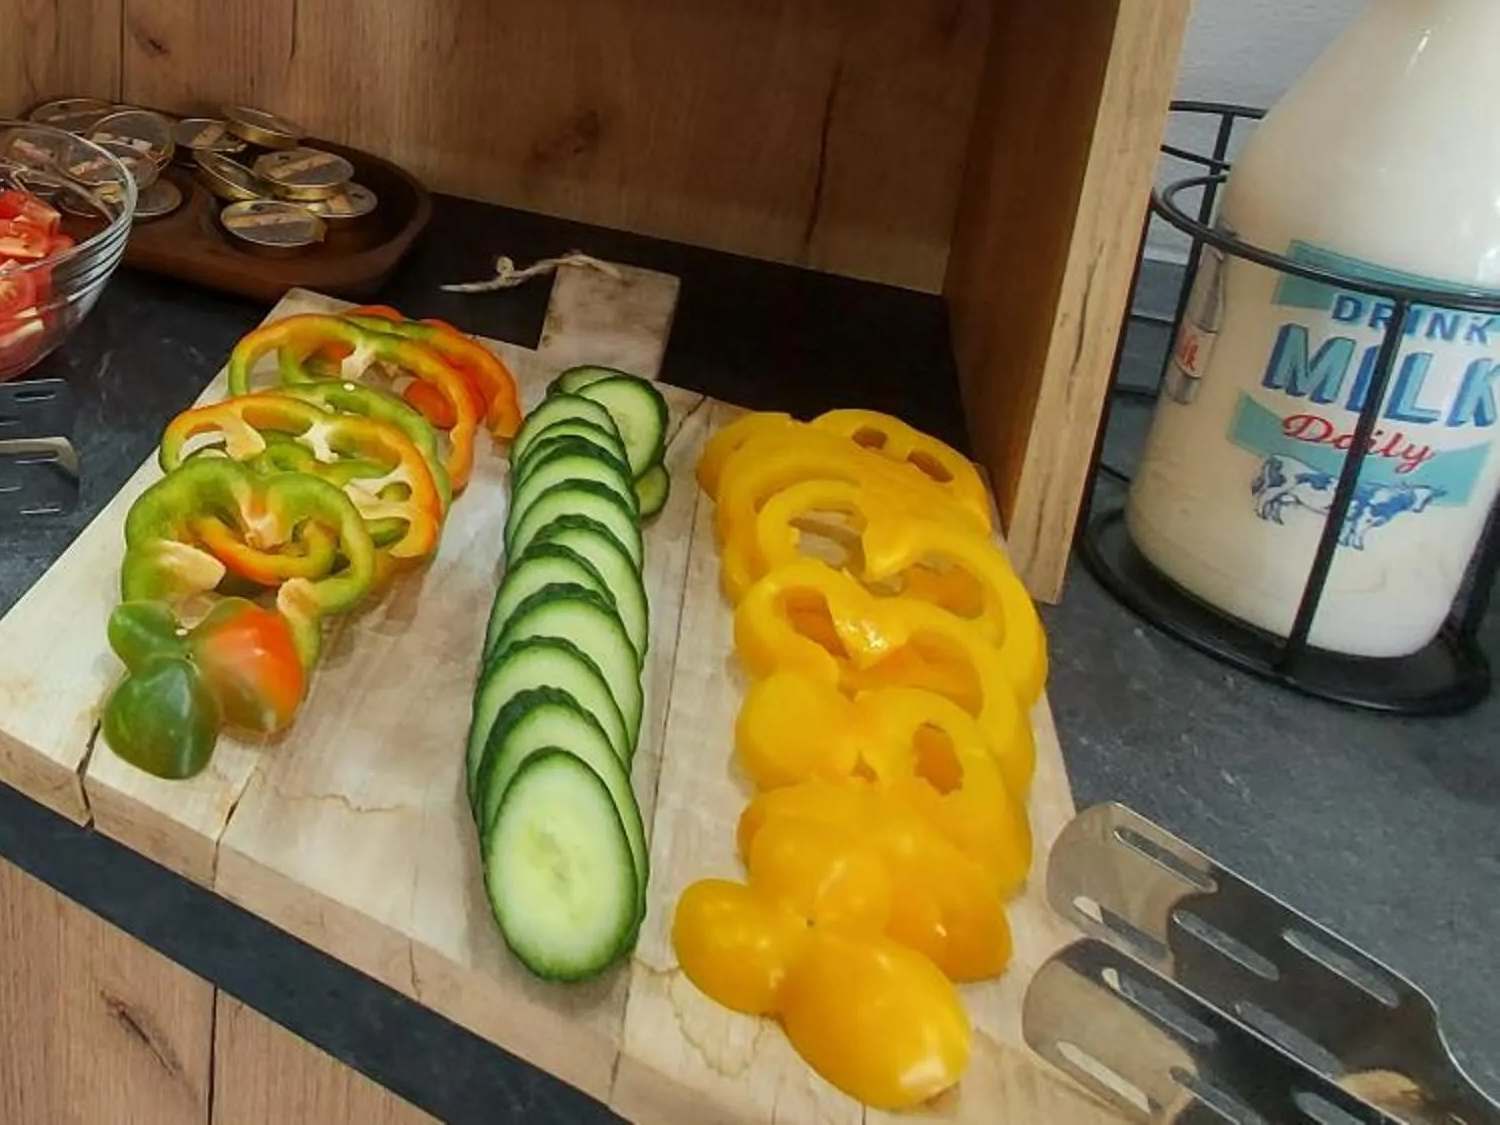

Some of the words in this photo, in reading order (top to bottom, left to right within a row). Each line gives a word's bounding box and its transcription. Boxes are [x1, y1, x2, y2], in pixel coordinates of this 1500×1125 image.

[1331, 294, 1497, 345] DRINK
[1262, 323, 1500, 428] MILK
[1283, 414, 1436, 475] Daily
